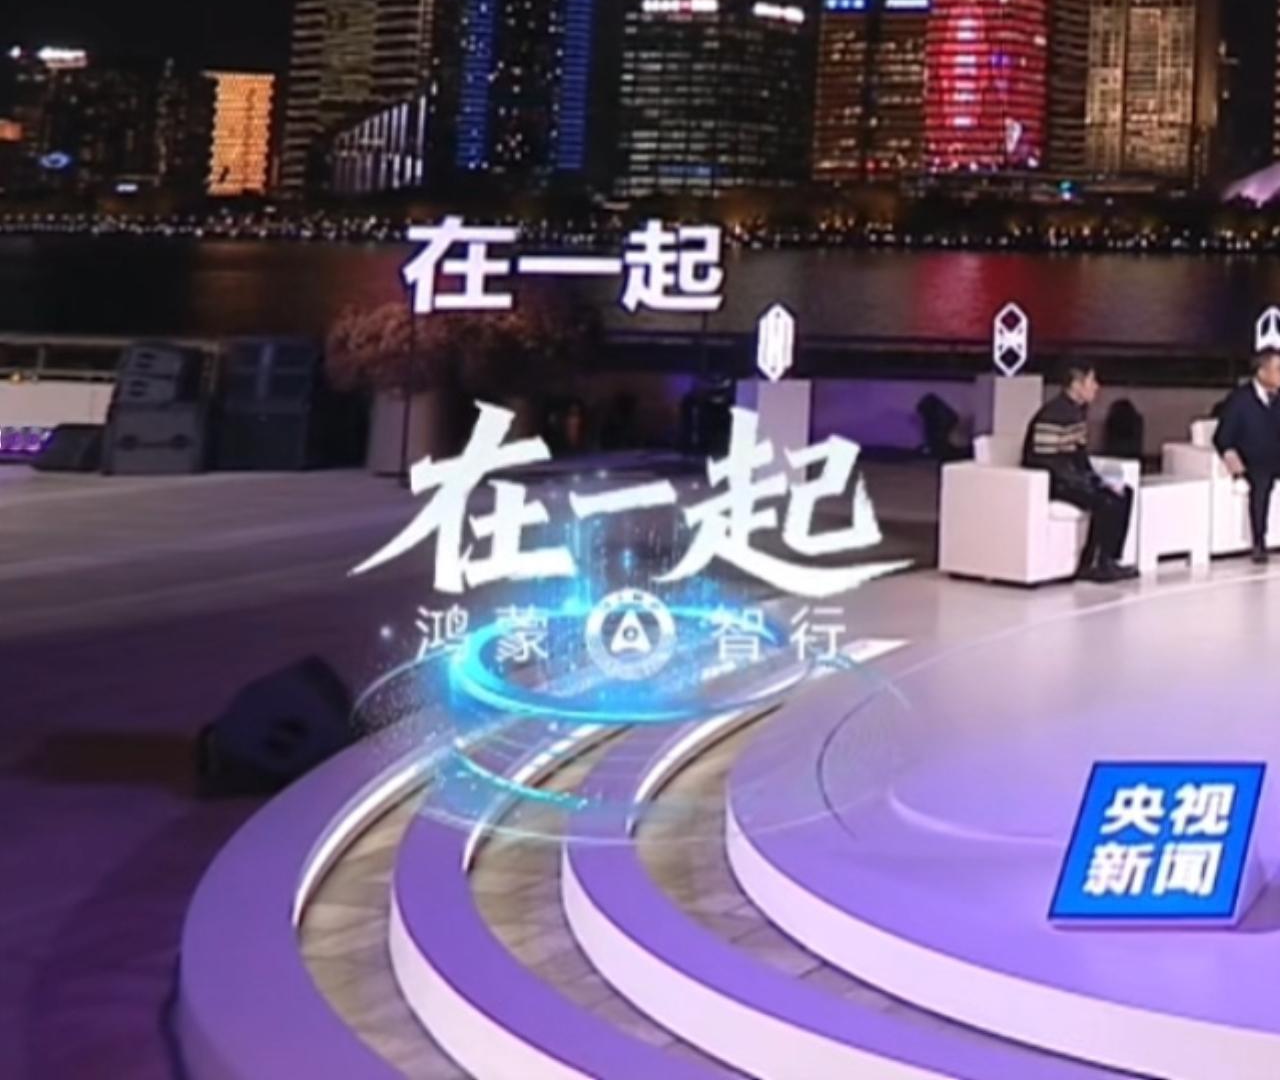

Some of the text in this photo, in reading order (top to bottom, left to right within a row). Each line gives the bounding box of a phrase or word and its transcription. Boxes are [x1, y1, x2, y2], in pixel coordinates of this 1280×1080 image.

[403, 215, 724, 313] 在一起
[1104, 783, 1236, 836] 央视
[1082, 843, 1225, 897] 新闻
